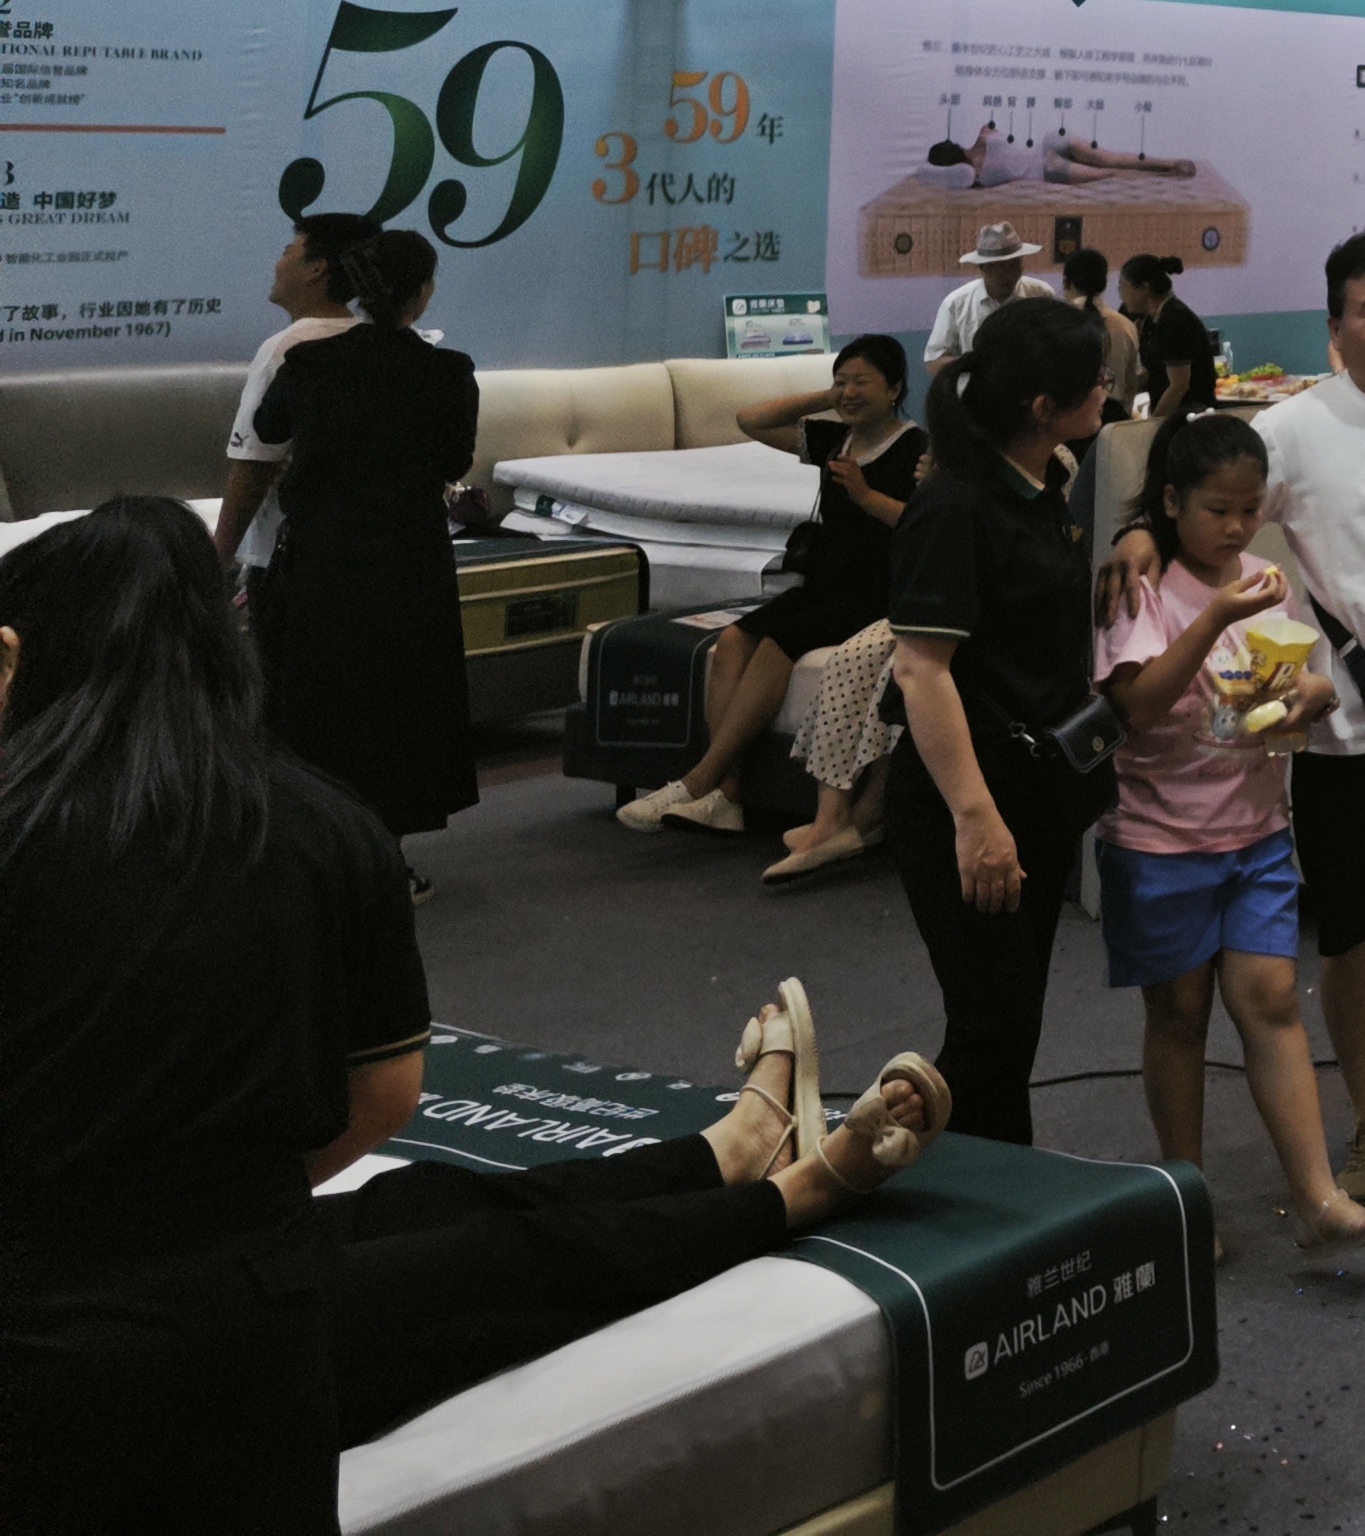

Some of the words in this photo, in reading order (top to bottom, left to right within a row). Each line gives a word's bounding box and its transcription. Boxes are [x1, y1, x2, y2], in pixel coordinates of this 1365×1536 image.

[33, 191, 118, 210] 中国好梦
[71, 212, 131, 224] DREAM
[30, 324, 121, 342] November
[423, 1099, 633, 1150] AIRLAND
[994, 1284, 1107, 1366] AIRLAND
[1113, 1260, 1155, 1304] 雅蘭
